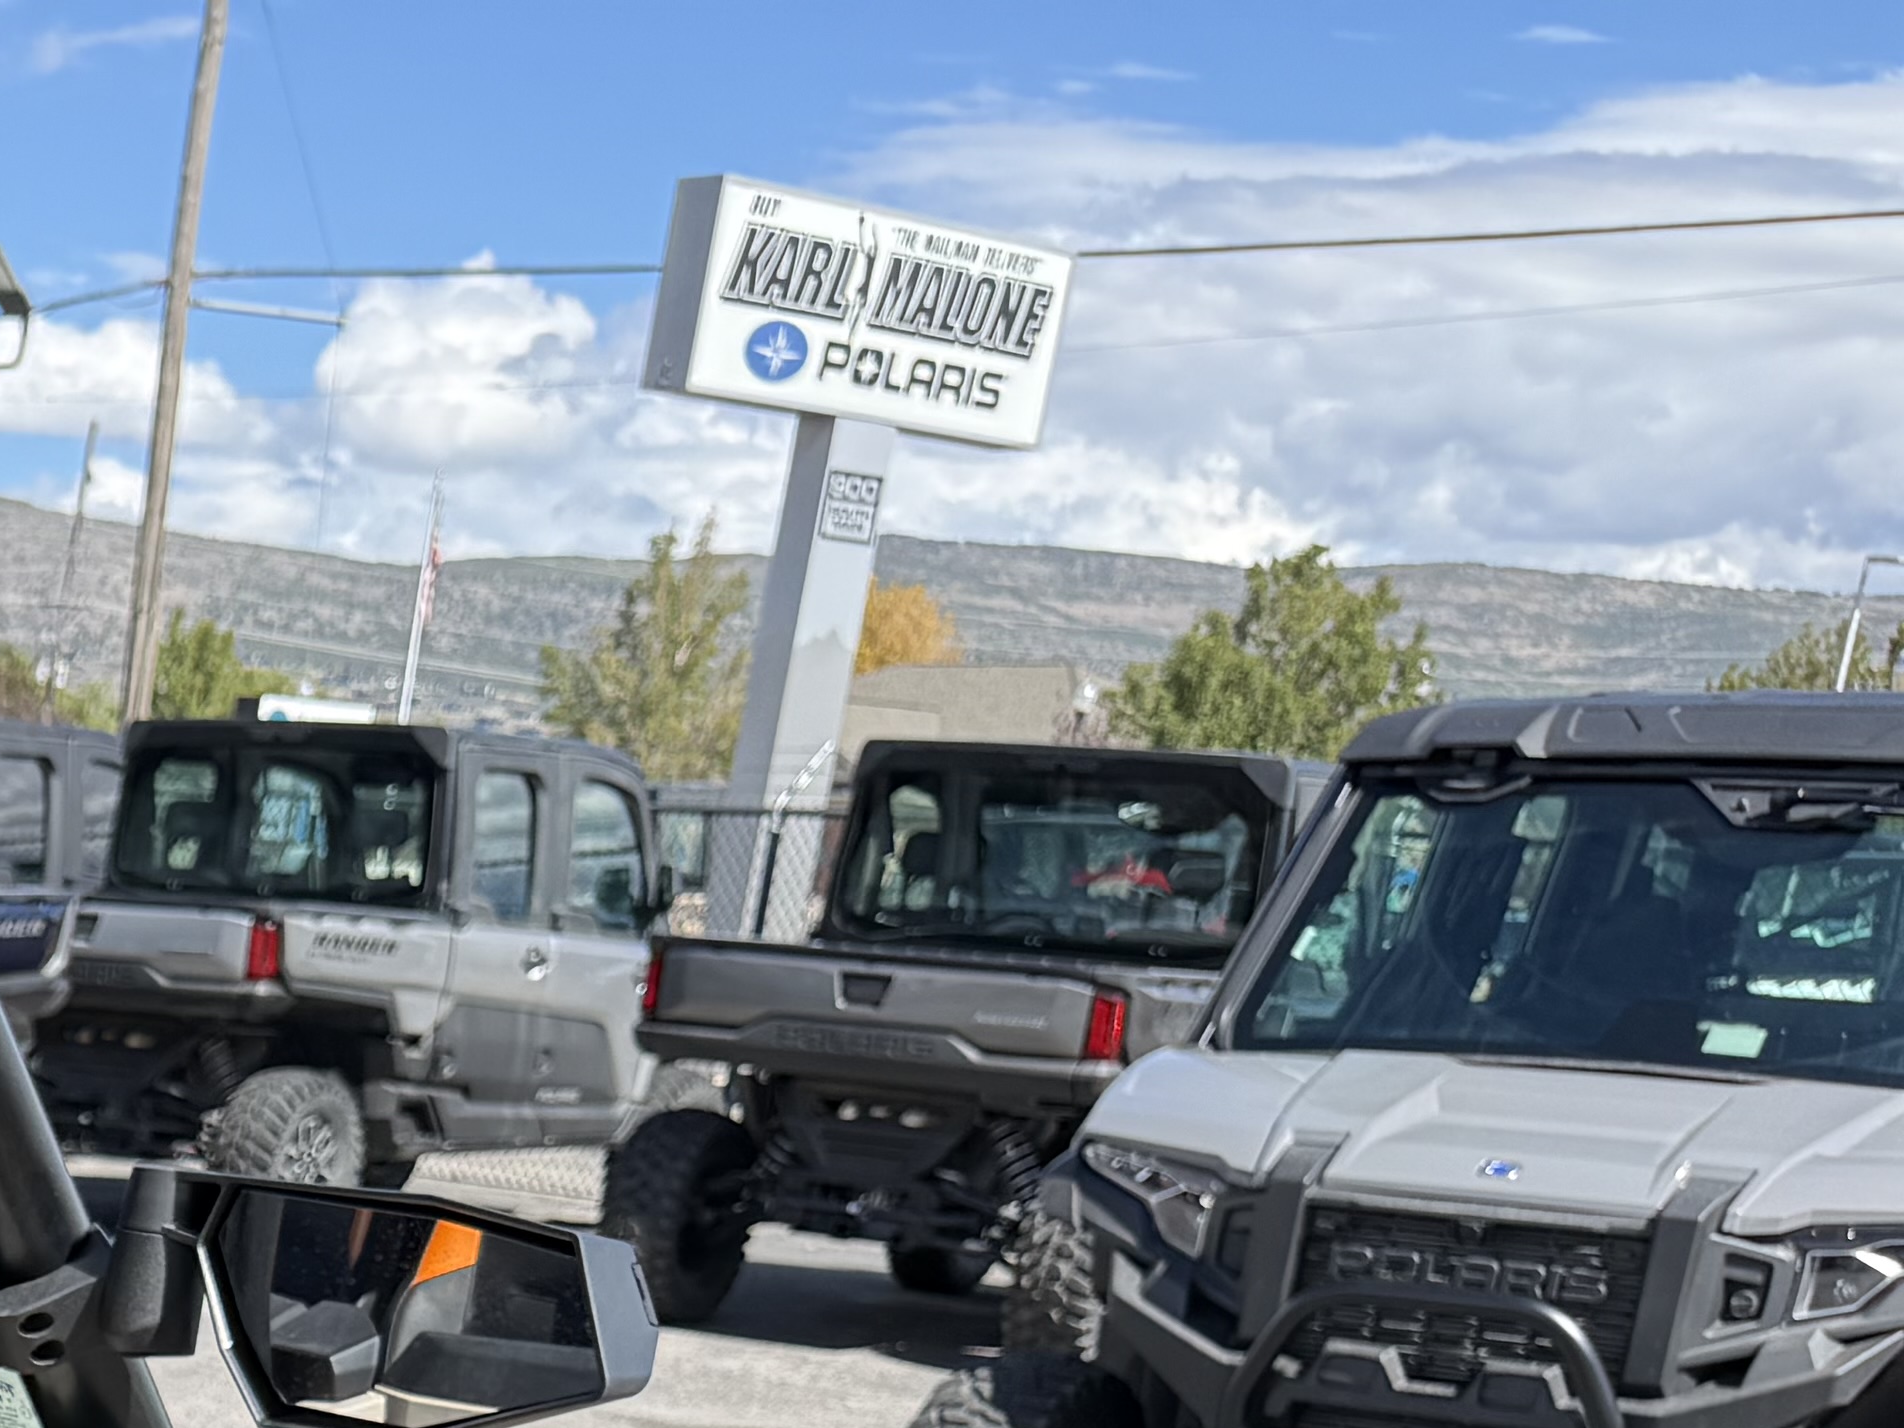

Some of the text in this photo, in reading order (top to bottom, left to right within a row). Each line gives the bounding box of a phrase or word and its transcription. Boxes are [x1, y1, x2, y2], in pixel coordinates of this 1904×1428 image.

[719, 221, 1054, 360] KARL MALONE
[817, 341, 1004, 409] POLARIS
[1330, 1246, 1609, 1304] POLARIS
